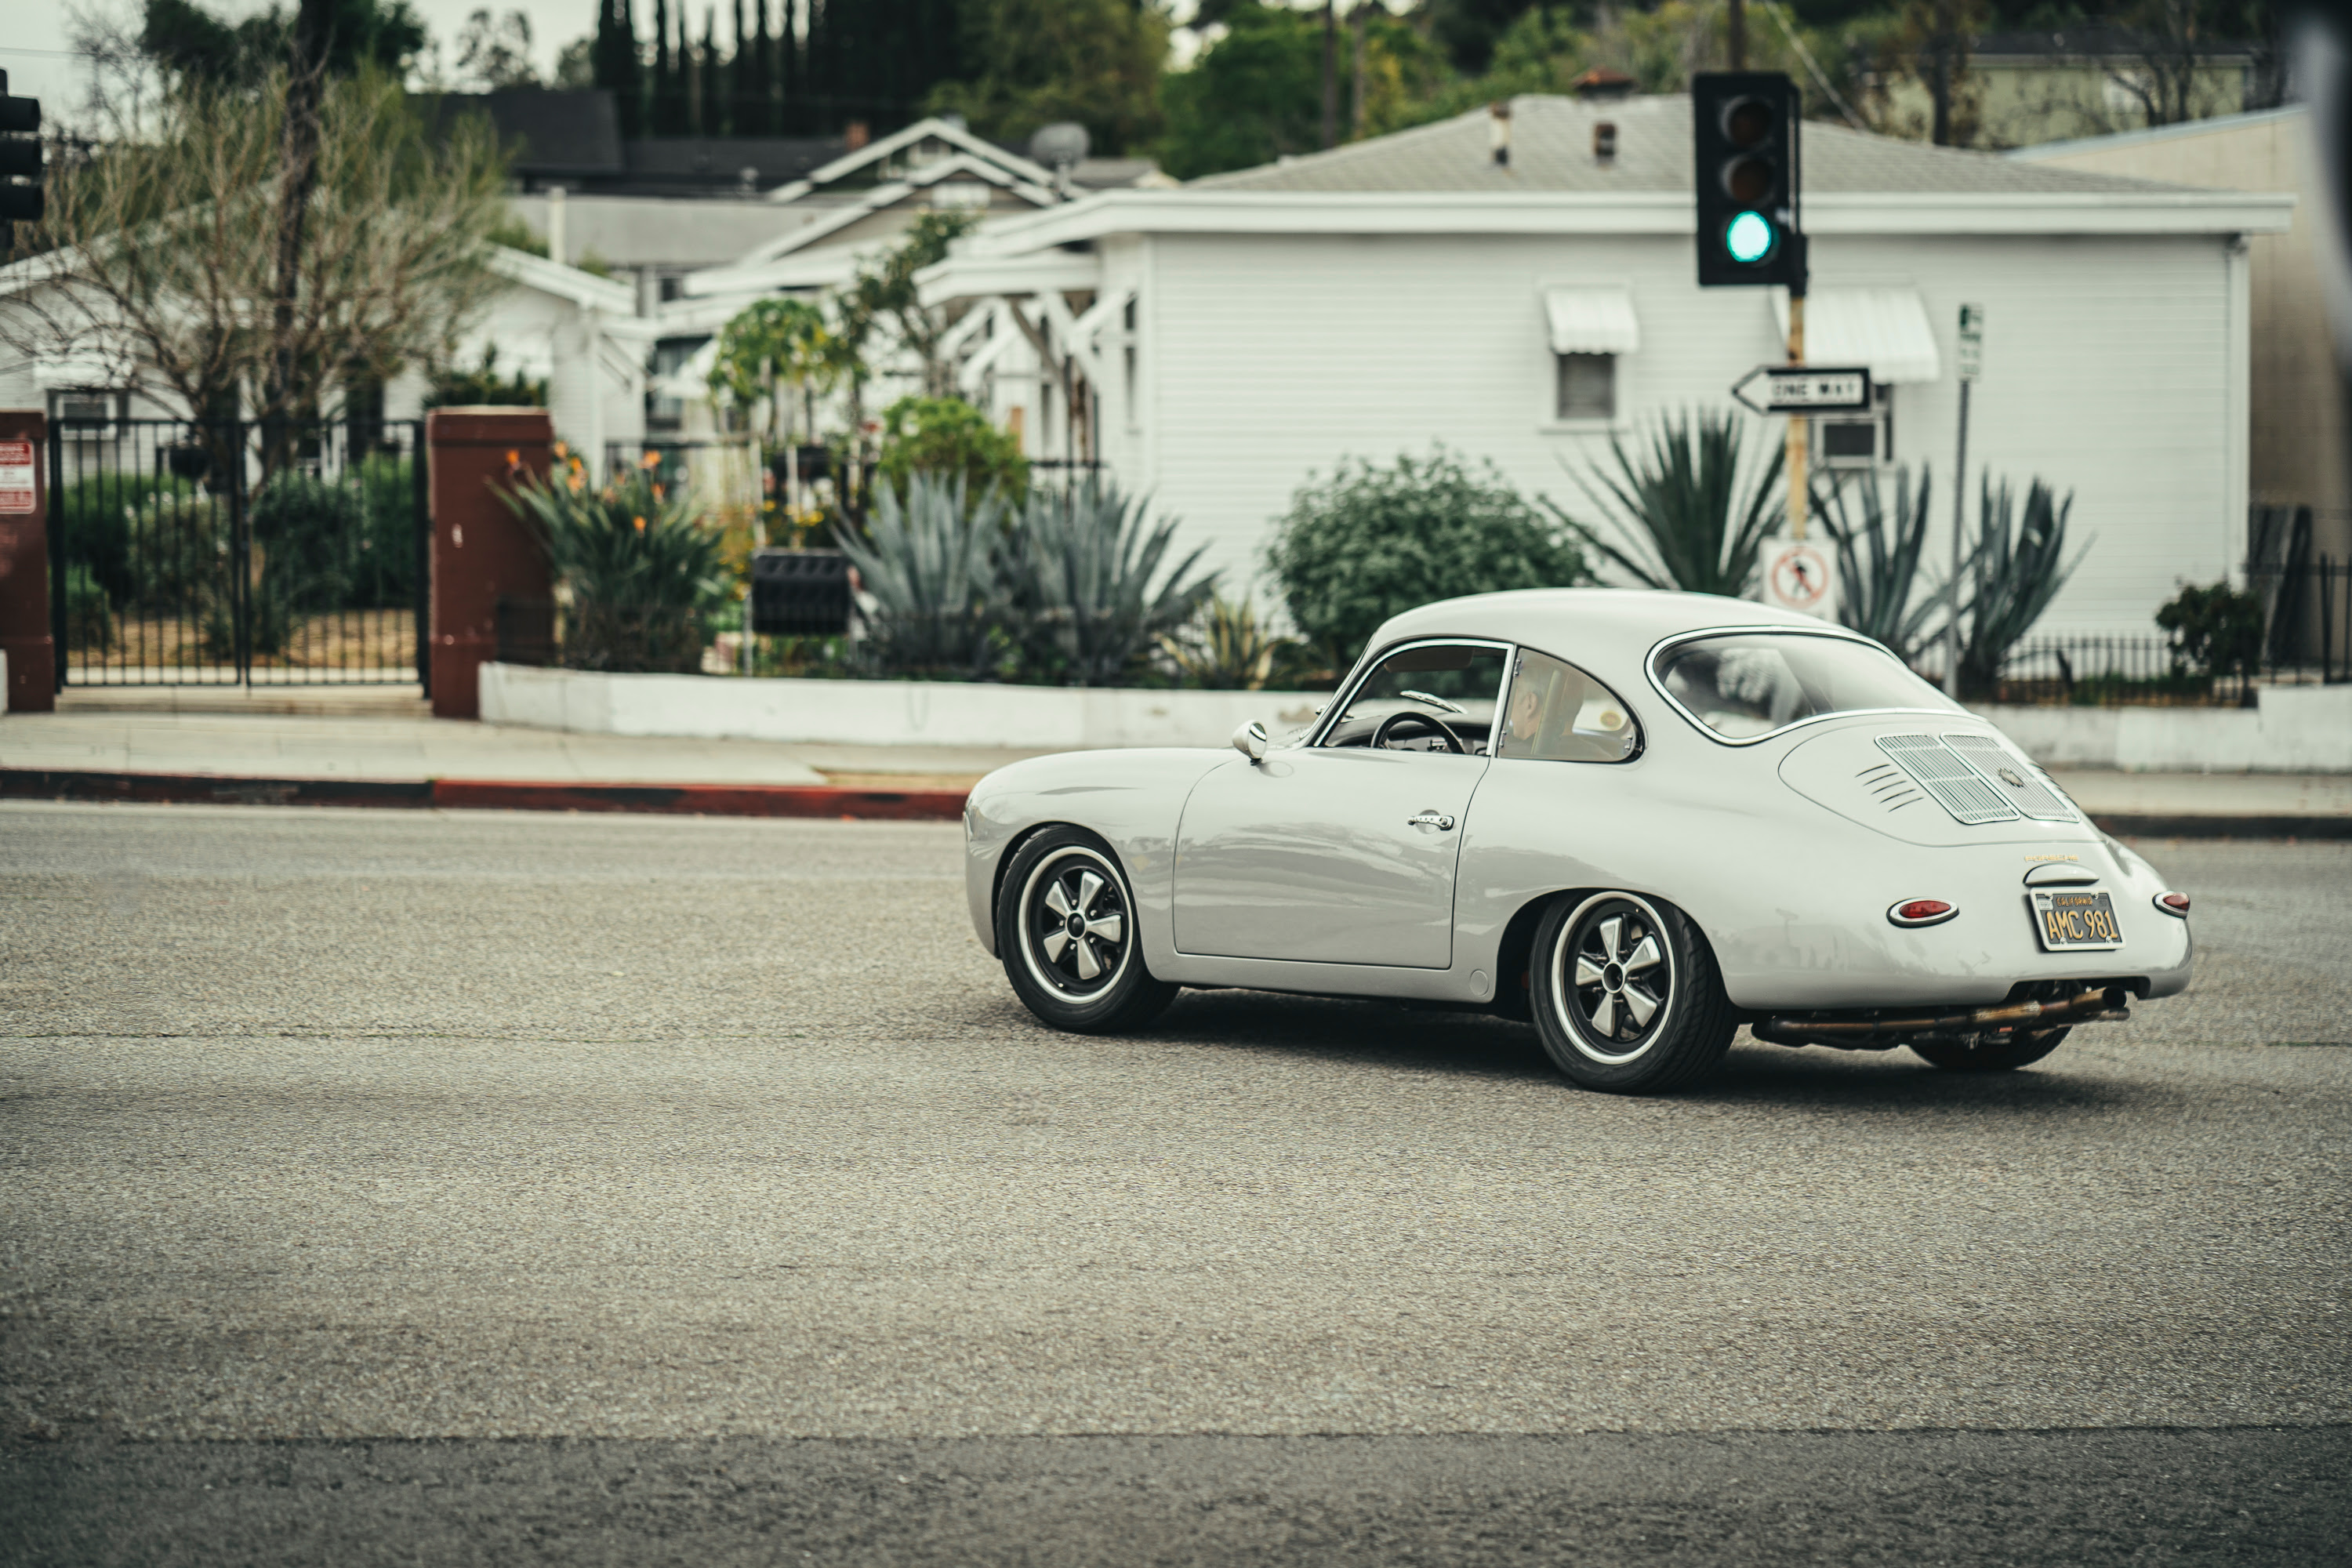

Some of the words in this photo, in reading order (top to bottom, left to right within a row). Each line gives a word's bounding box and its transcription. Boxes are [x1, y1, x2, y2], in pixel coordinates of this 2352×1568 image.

[2024, 854, 2079, 862] PORSCHE
[2056, 896, 2093, 907] CALIFORNIA
[2046, 910, 2083, 939] AMC
[2084, 909, 2118, 939] 981
